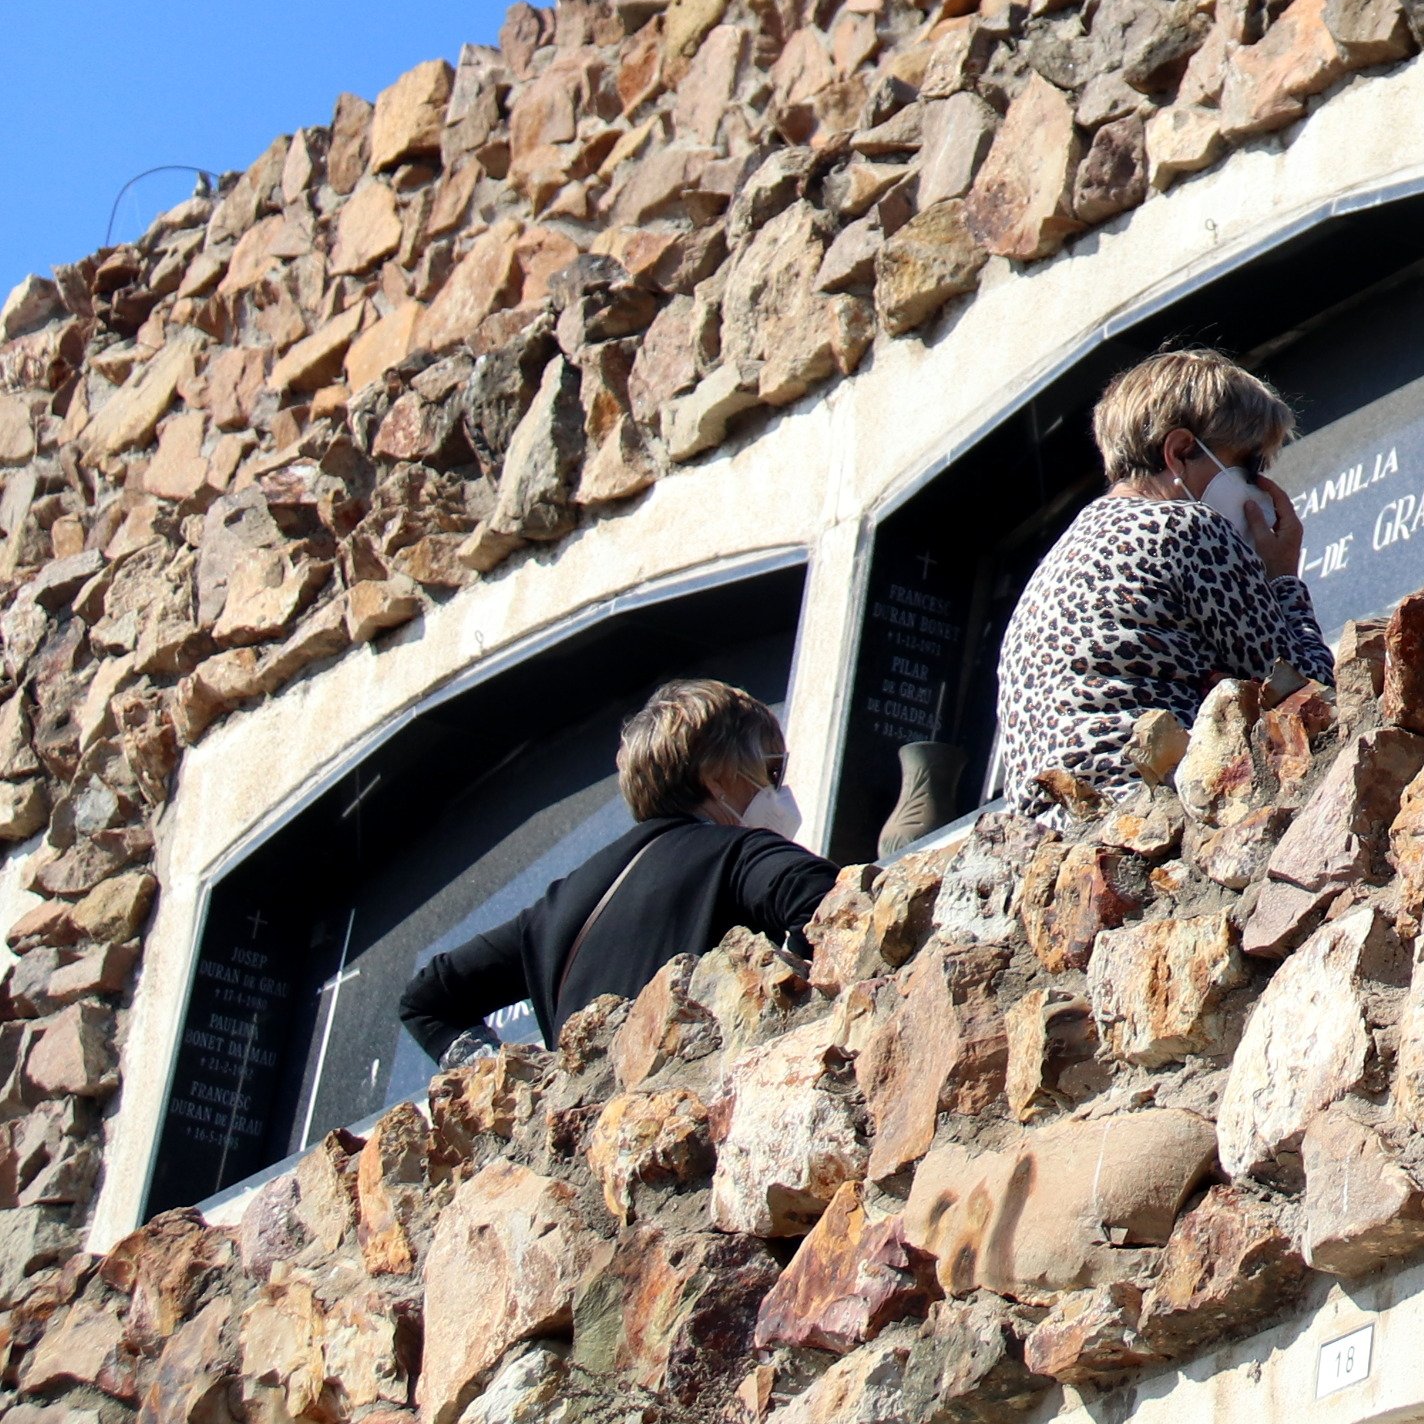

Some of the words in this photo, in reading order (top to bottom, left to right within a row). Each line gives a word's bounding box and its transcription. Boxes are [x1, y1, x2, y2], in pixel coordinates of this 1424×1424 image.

[1291, 446, 1399, 520] FAMILIA
[889, 583, 952, 615] FRANCESC
[873, 601, 916, 628] DURAN
[891, 655, 930, 681] PILAR
[899, 680, 933, 705] GRAU
[230, 946, 269, 970] JOSEP
[199, 958, 240, 986] DURAN
[259, 975, 290, 999] GRAU
[171, 1096, 212, 1122] DURAN
[1334, 1345, 1356, 1378] 18
